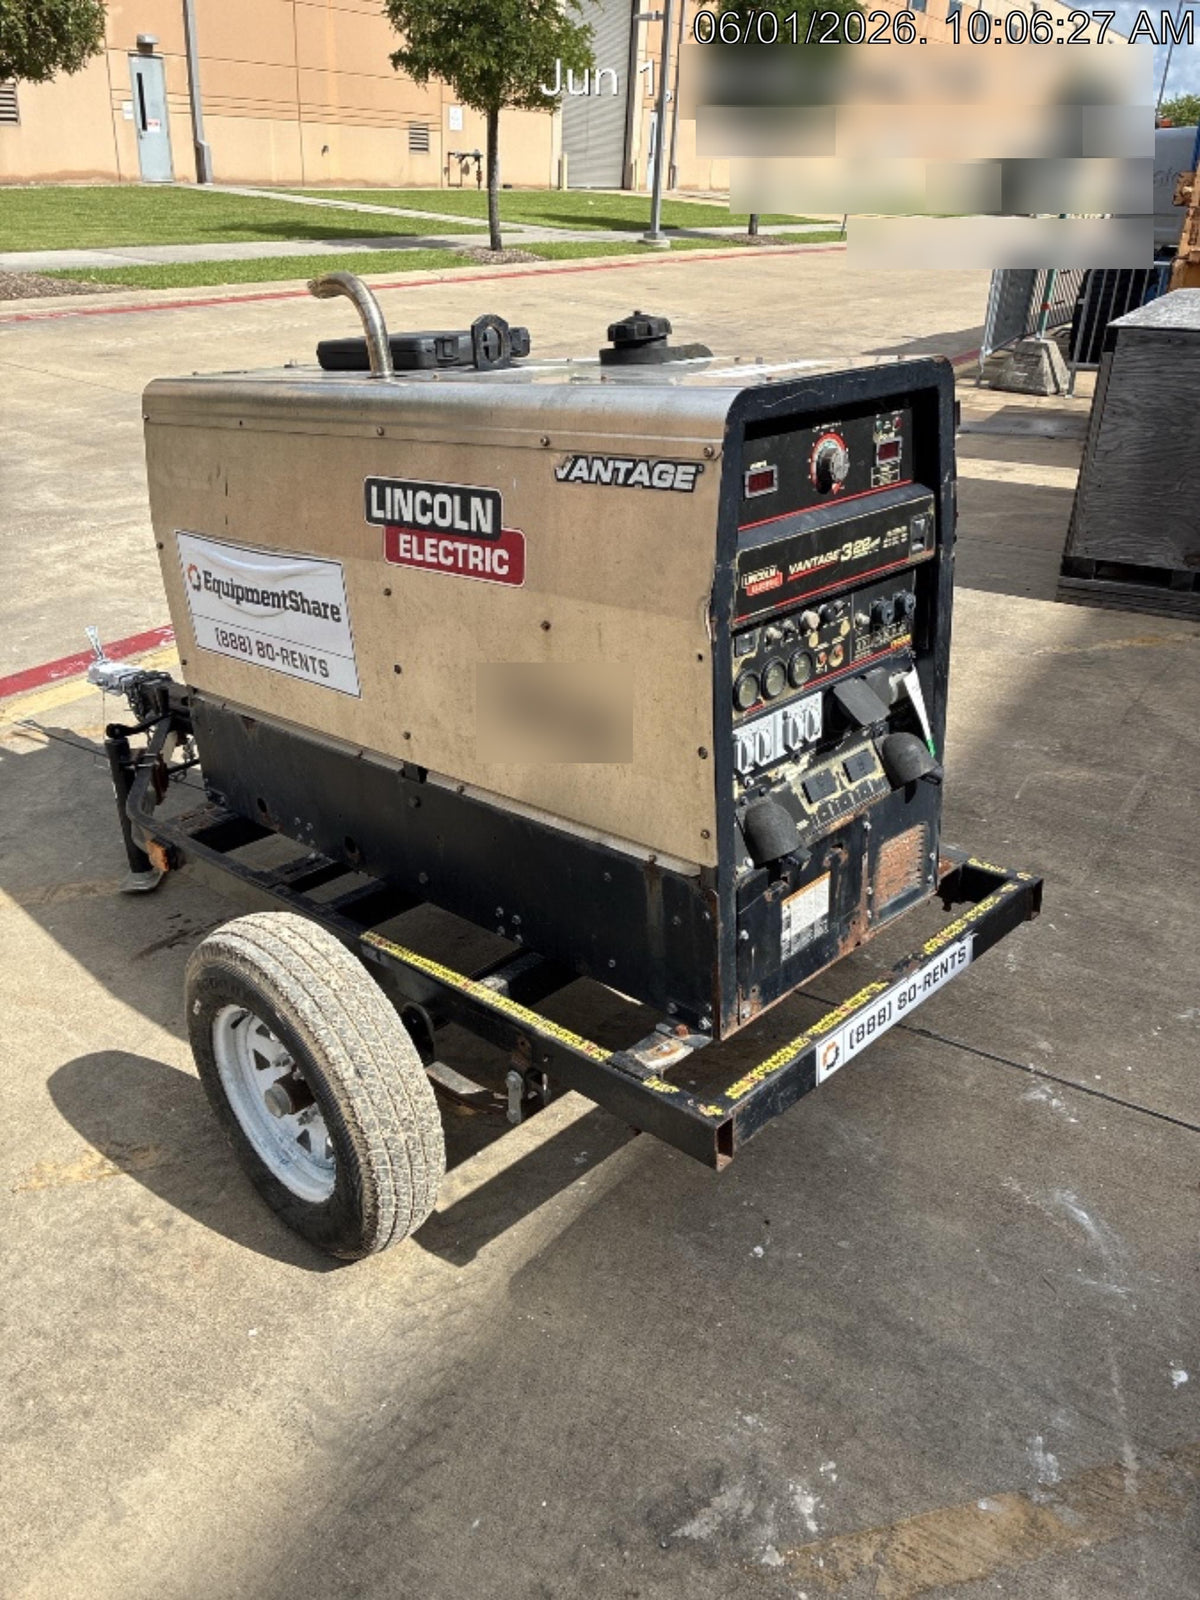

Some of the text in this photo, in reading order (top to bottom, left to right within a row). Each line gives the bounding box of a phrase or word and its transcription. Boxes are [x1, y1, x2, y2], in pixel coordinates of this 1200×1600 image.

[369, 485, 494, 534] LINCOLN
[398, 533, 511, 576] ELECTRIC
[788, 549, 840, 575] VANTAGE
[202, 570, 344, 624] EquipmentShare
[214, 626, 330, 679] (888) 80-RENTS
[849, 1001, 893, 1050] (888)
[896, 946, 968, 1012] 80-RENTS
